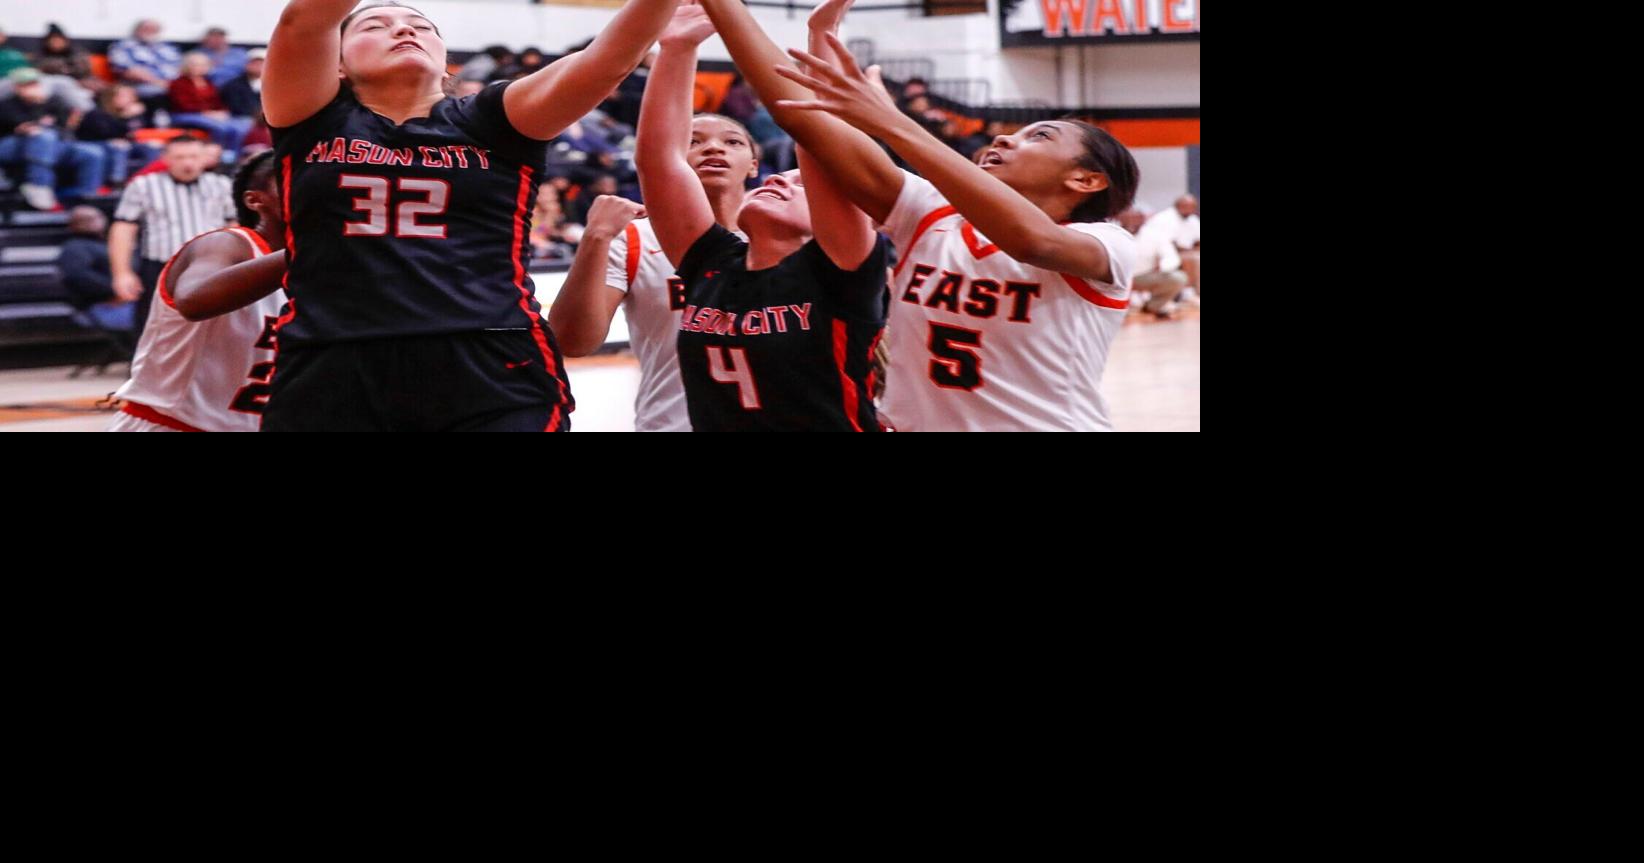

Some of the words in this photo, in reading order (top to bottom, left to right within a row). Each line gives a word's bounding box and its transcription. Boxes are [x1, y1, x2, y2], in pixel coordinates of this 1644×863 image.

[305, 136, 414, 167] MASON
[418, 145, 491, 170] CITY
[338, 173, 450, 240] 32
[740, 302, 812, 336] CITY
[901, 262, 1041, 324] EAST
[705, 345, 761, 411] 4
[927, 319, 984, 392] 5
